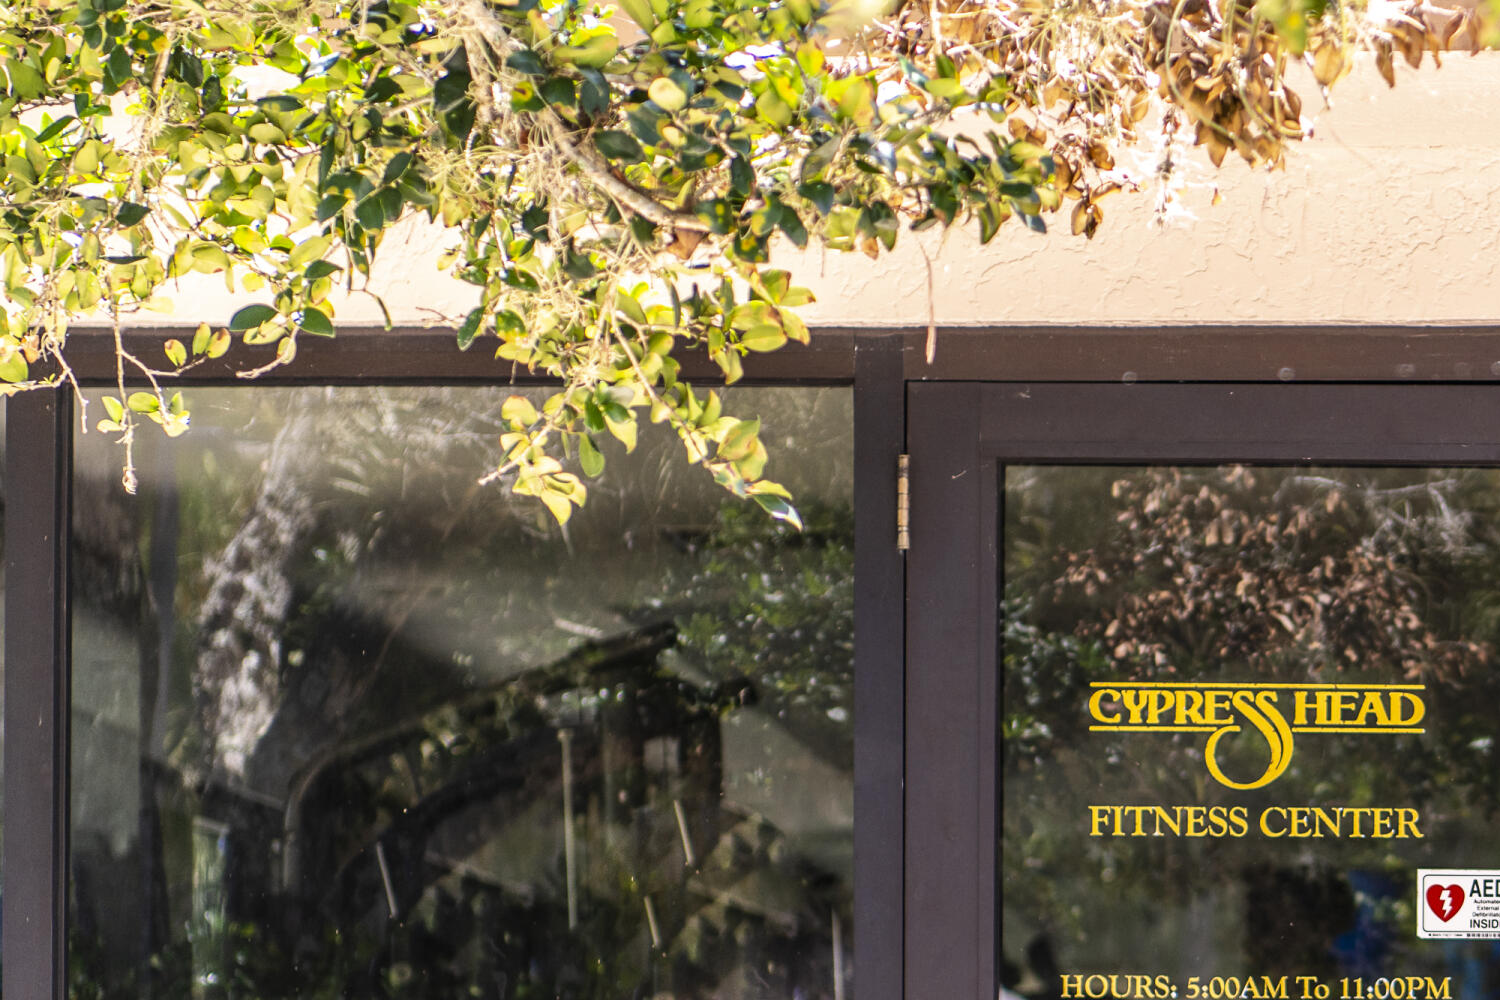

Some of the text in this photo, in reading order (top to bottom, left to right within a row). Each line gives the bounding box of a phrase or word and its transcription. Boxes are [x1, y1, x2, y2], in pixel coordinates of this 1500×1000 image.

[1089, 689, 1425, 790] CYPRESS HEAD
[1088, 806, 1424, 838] FITNESS CENTER
[1061, 975, 1452, 1000] HOURS: 5:00AM To 11:00PM
